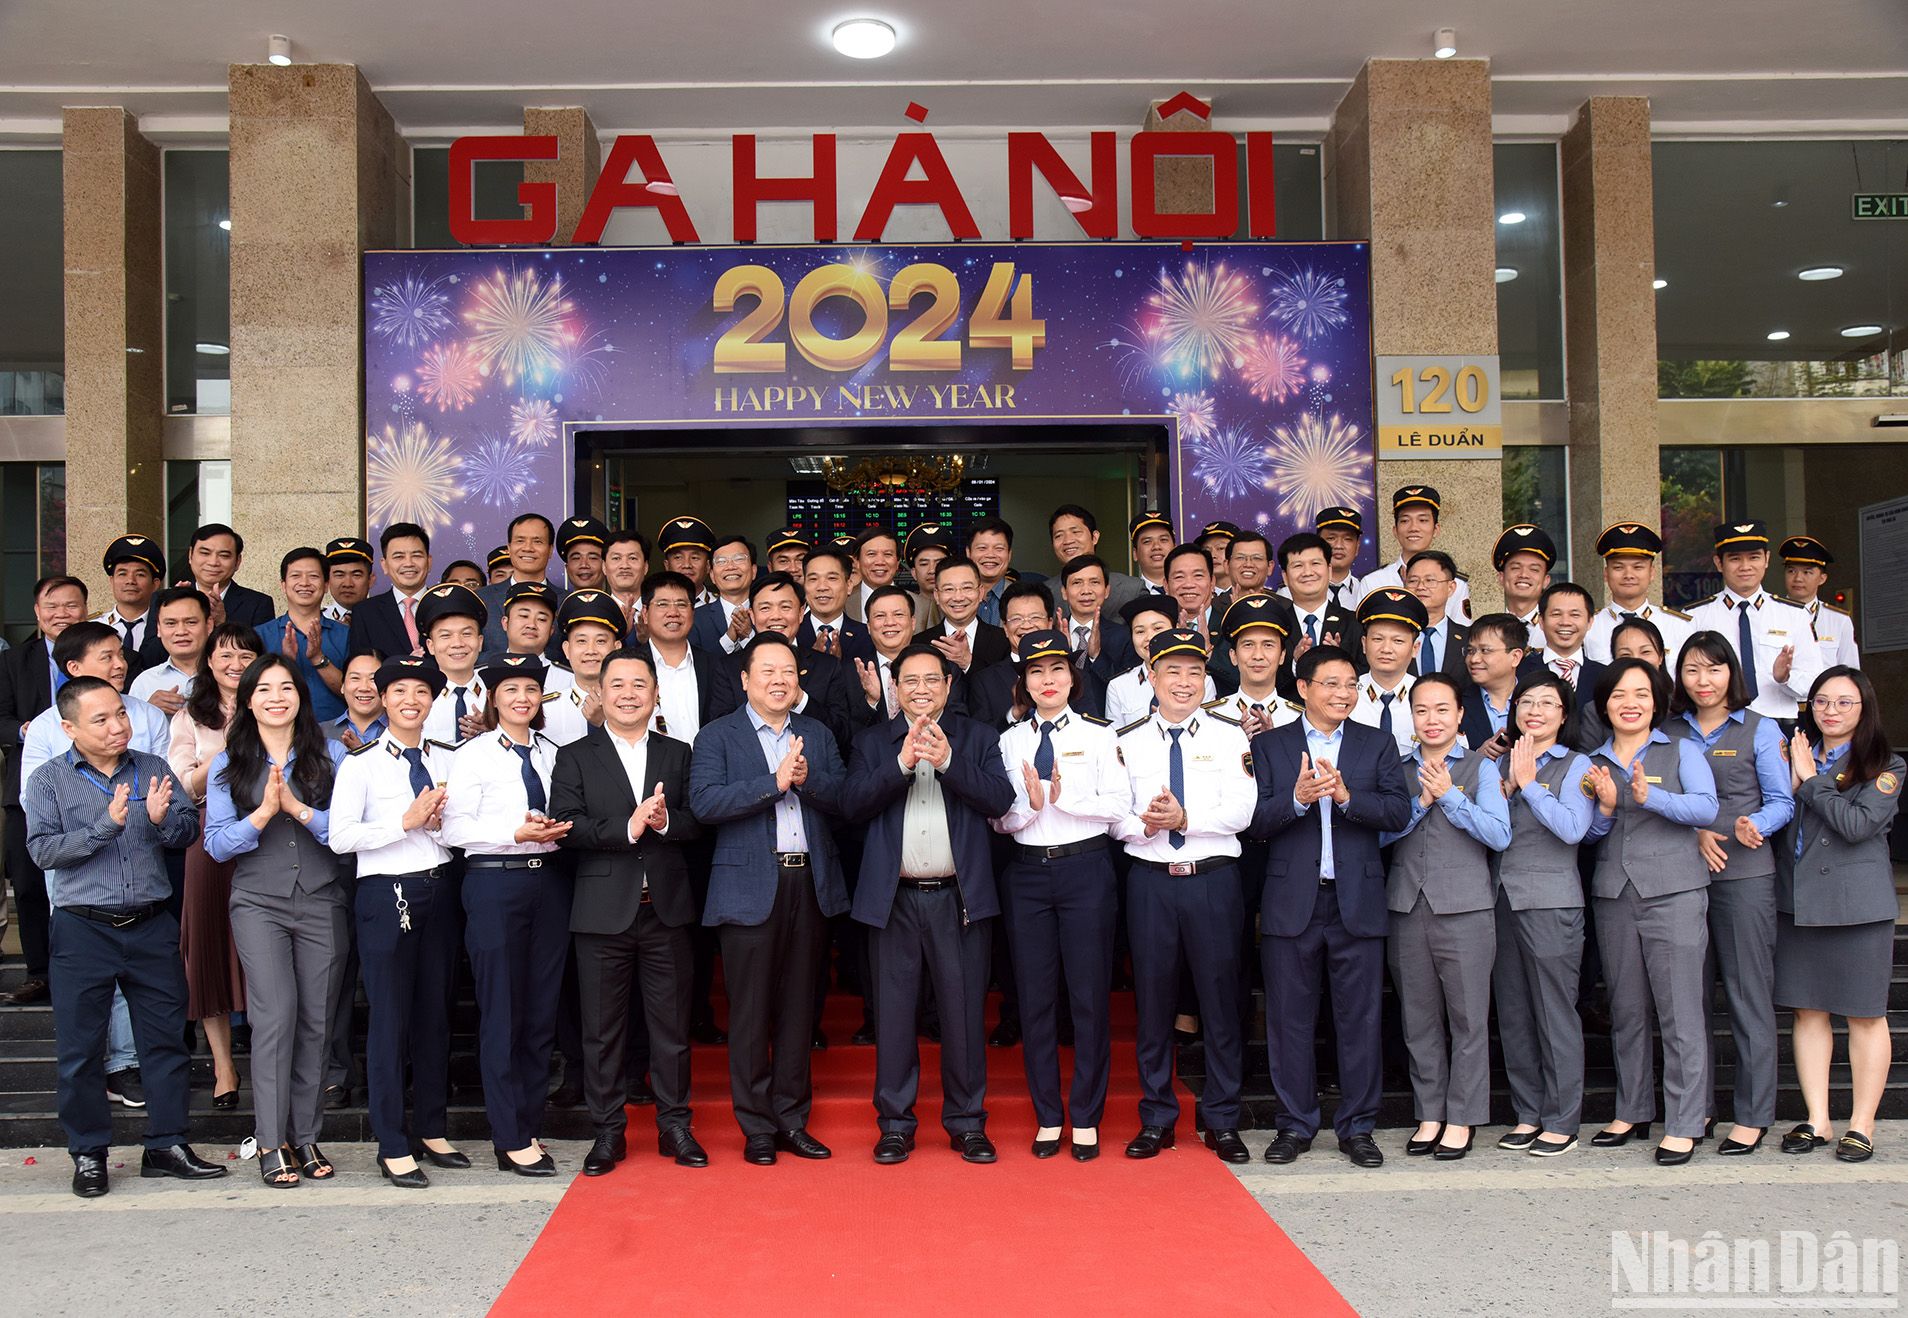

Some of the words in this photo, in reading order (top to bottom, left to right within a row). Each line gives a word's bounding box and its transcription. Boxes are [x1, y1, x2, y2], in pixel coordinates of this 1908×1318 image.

[448, 134, 701, 245] GA
[732, 100, 982, 242] HÀ
[1008, 91, 1277, 252] NỘI
[1858, 197, 1908, 216] EXIT
[713, 261, 1046, 374] 2024
[714, 386, 829, 411] HAPPY
[838, 385, 919, 410] NEW
[928, 384, 1017, 410] YEAR
[1391, 365, 1489, 414] 120
[1398, 431, 1422, 447] LÊ
[1429, 427, 1484, 447] DUẨN
